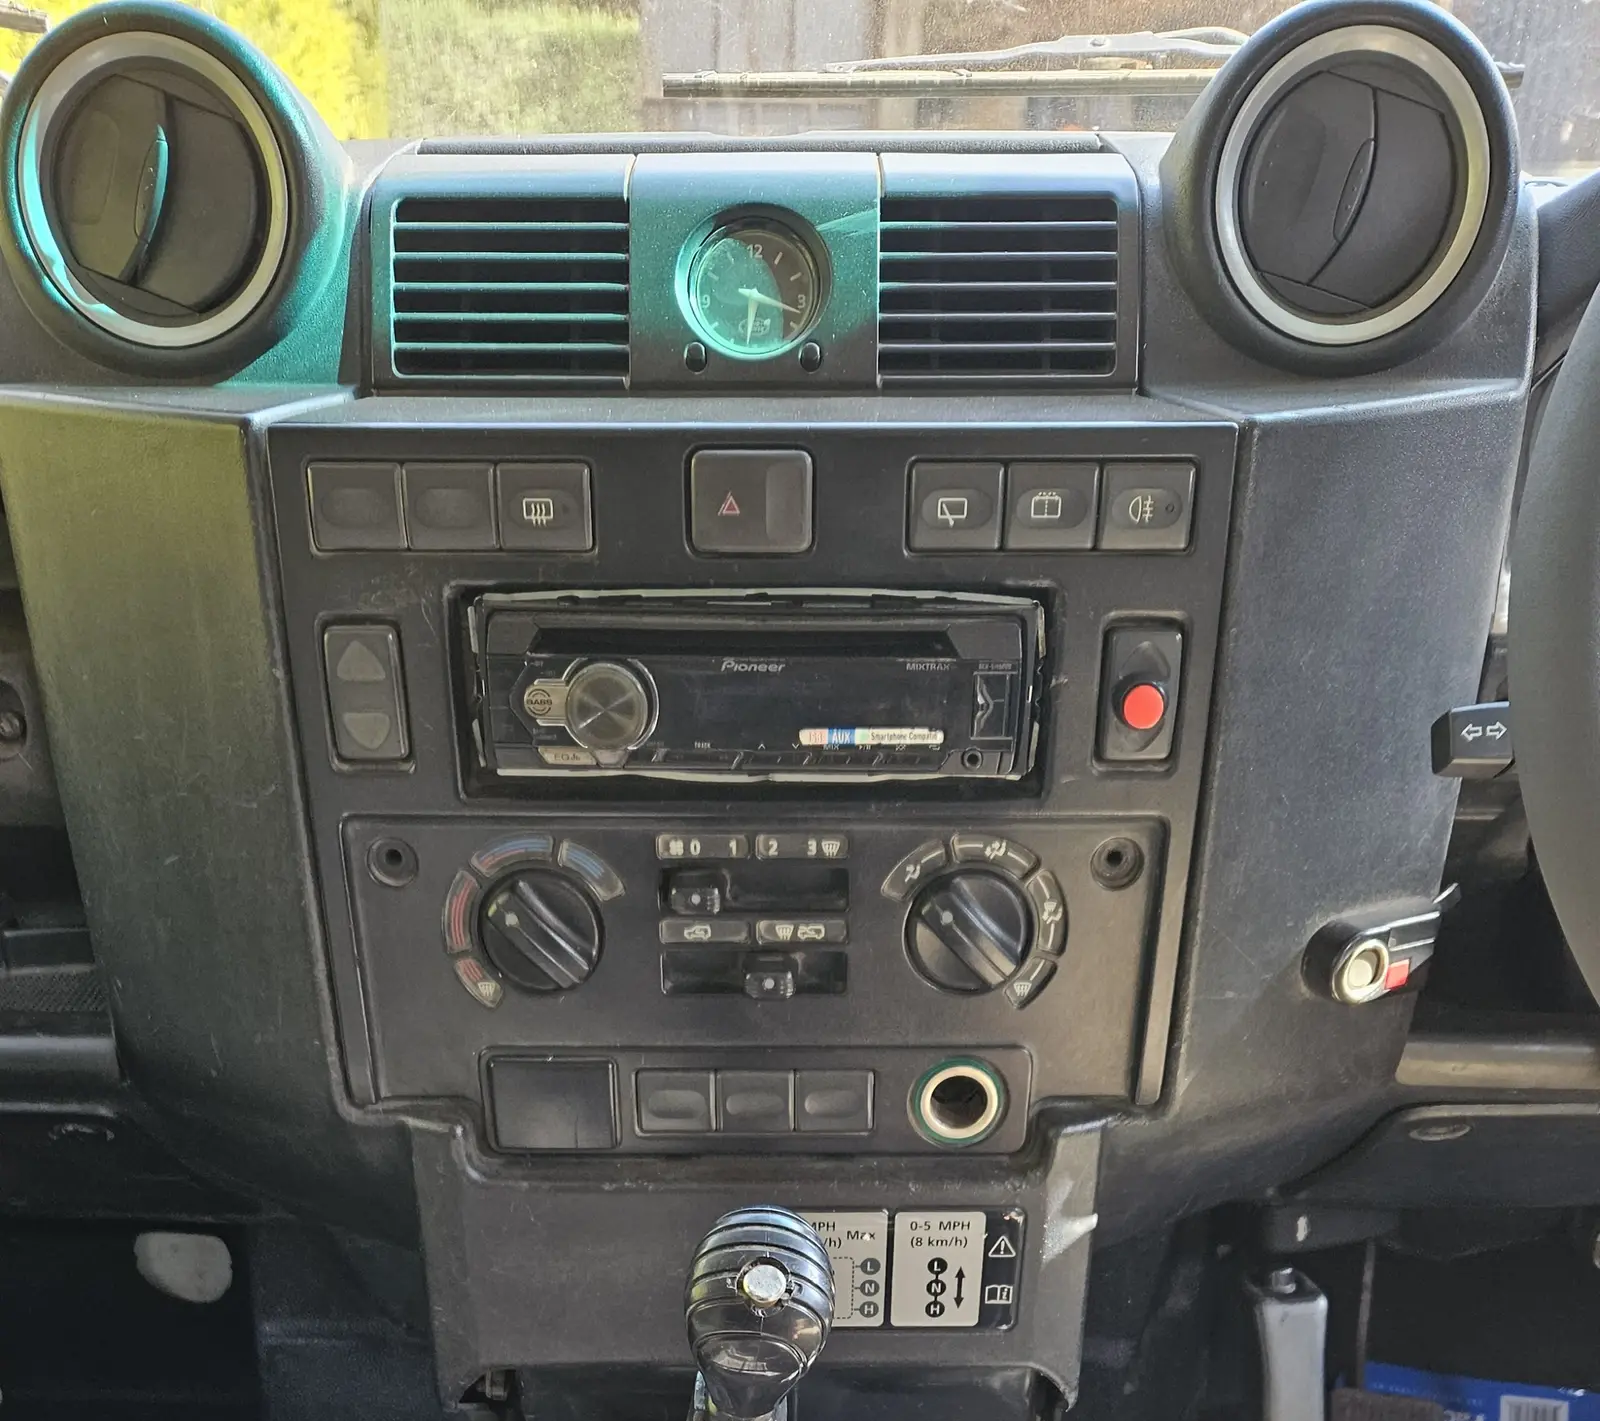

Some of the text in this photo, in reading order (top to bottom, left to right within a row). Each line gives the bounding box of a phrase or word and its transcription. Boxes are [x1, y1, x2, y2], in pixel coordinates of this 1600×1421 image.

[746, 244, 763, 259] 12
[702, 293, 711, 309] 9
[720, 660, 786, 672] Pioneer
[906, 663, 950, 671] MIXTRAX
[832, 731, 851, 744] AUX
[690, 838, 817, 856] 0 1 2 3
[910, 1220, 971, 1231] 0-5 MPH
[910, 1236, 968, 1248] (8 km/h)
[866, 1260, 875, 1272] L
[933, 1260, 942, 1272] L
[864, 1282, 875, 1294] N
[931, 1282, 942, 1294] N
[864, 1304, 874, 1315] H
[930, 1304, 940, 1315] H
